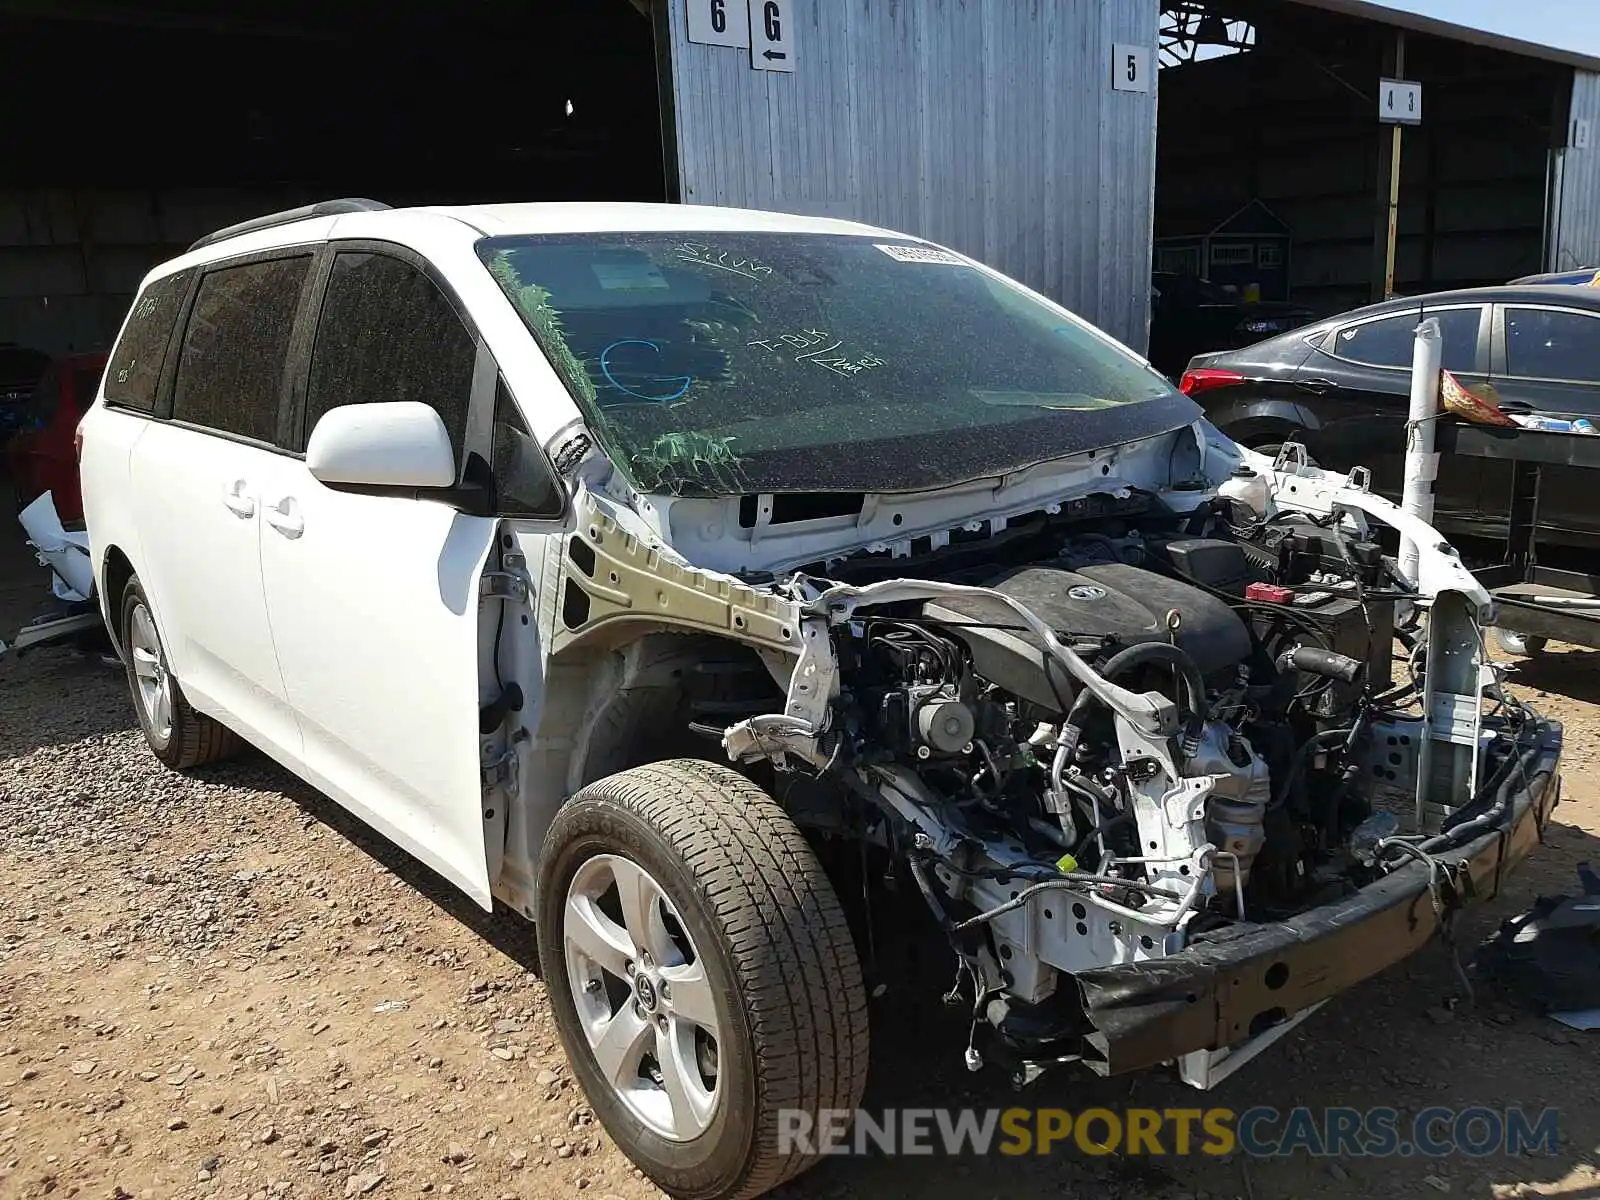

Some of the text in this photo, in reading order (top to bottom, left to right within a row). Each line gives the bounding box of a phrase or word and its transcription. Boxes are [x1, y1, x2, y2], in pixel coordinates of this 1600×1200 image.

[711, 0, 726, 32] 6
[764, 1, 781, 41] G
[1127, 54, 1136, 82] 5
[1387, 90, 1414, 112] 4 3
